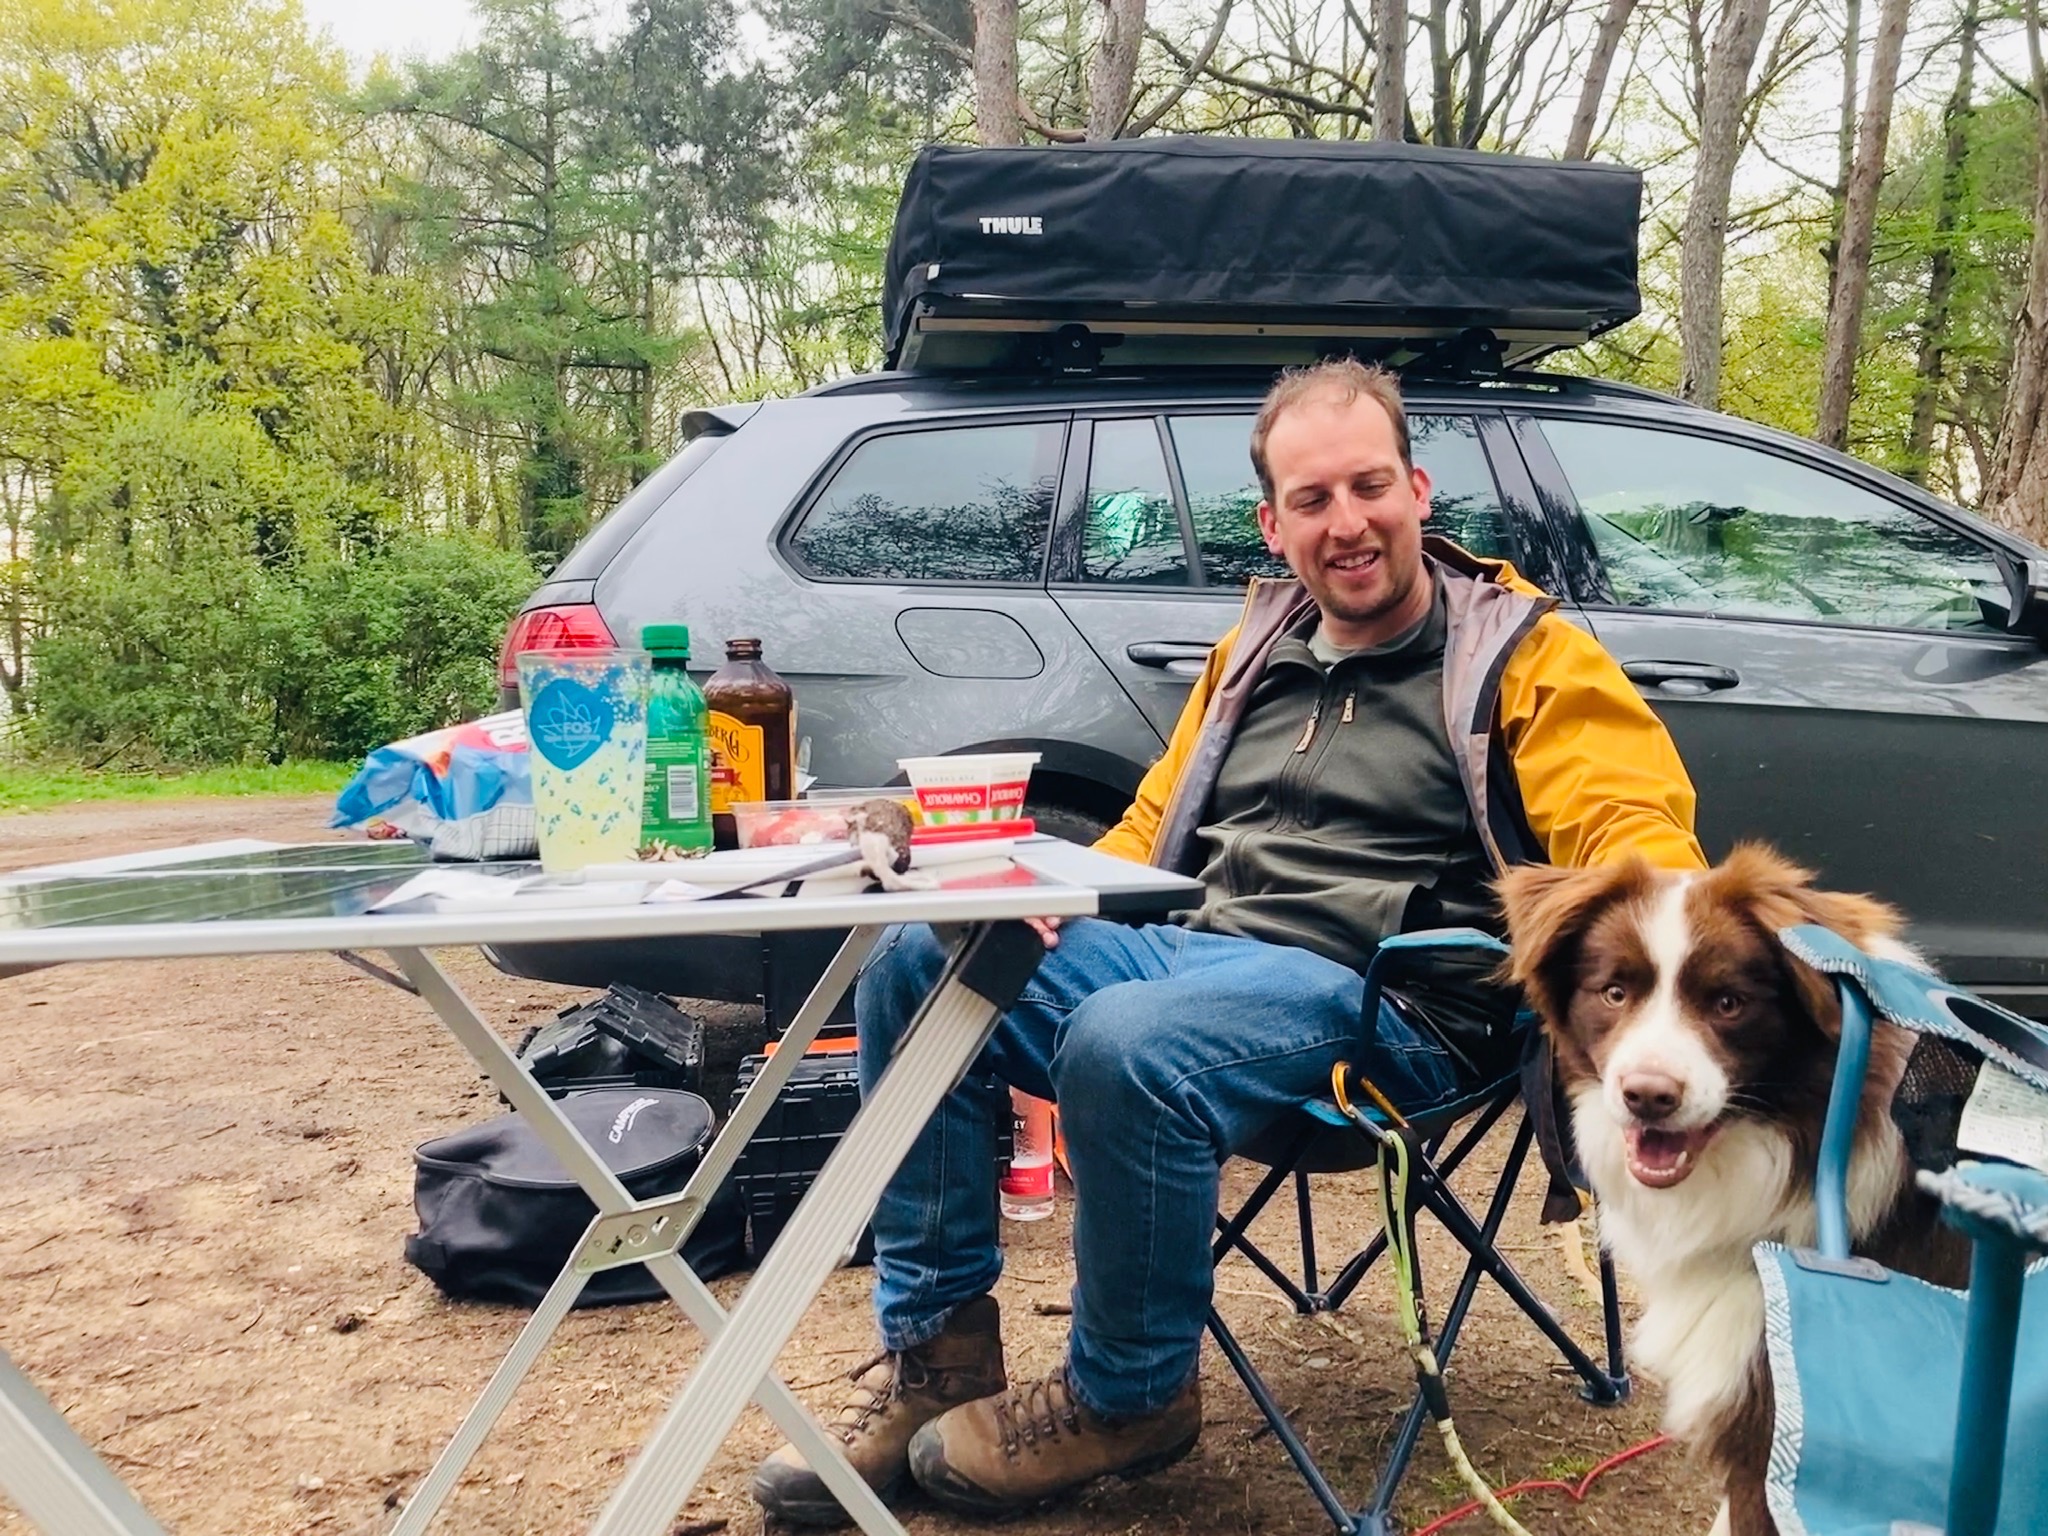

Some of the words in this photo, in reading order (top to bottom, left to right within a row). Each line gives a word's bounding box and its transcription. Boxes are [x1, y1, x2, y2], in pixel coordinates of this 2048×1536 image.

[979, 216, 1043, 235] THULE
[563, 721, 592, 734] FOS
[923, 791, 982, 806] CHAVROUX
